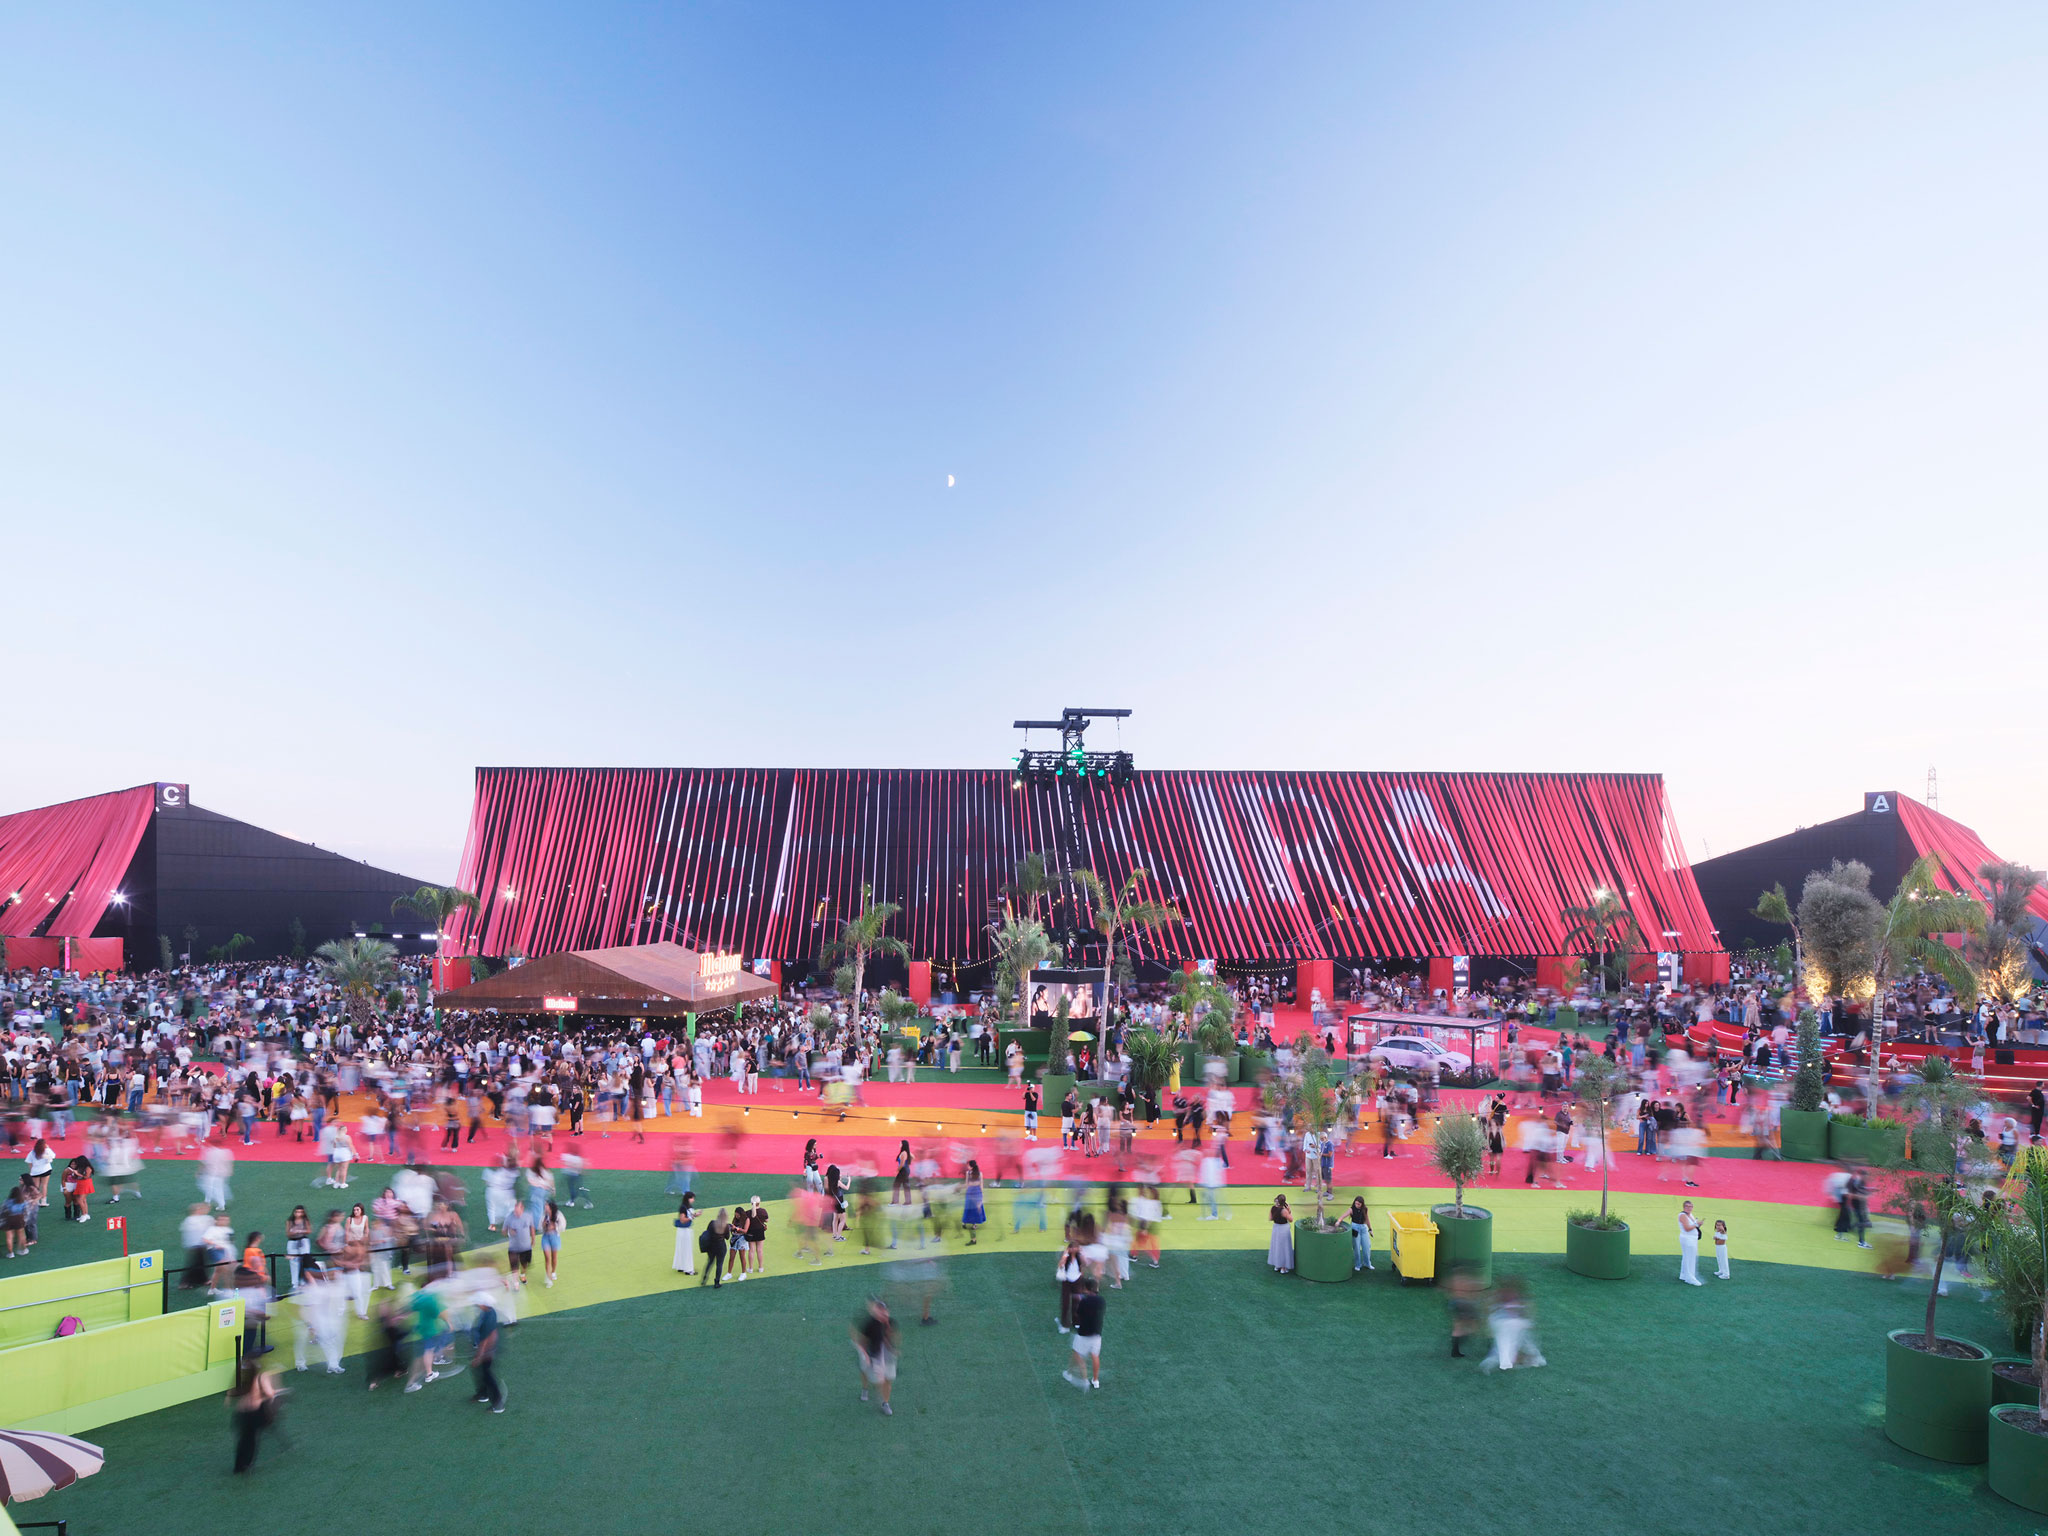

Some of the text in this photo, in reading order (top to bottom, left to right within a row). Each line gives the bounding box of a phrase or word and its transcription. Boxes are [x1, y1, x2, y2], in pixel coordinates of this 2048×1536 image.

[163, 785, 181, 805] C
[1872, 794, 1890, 812] A
[699, 949, 742, 976] Mahou
